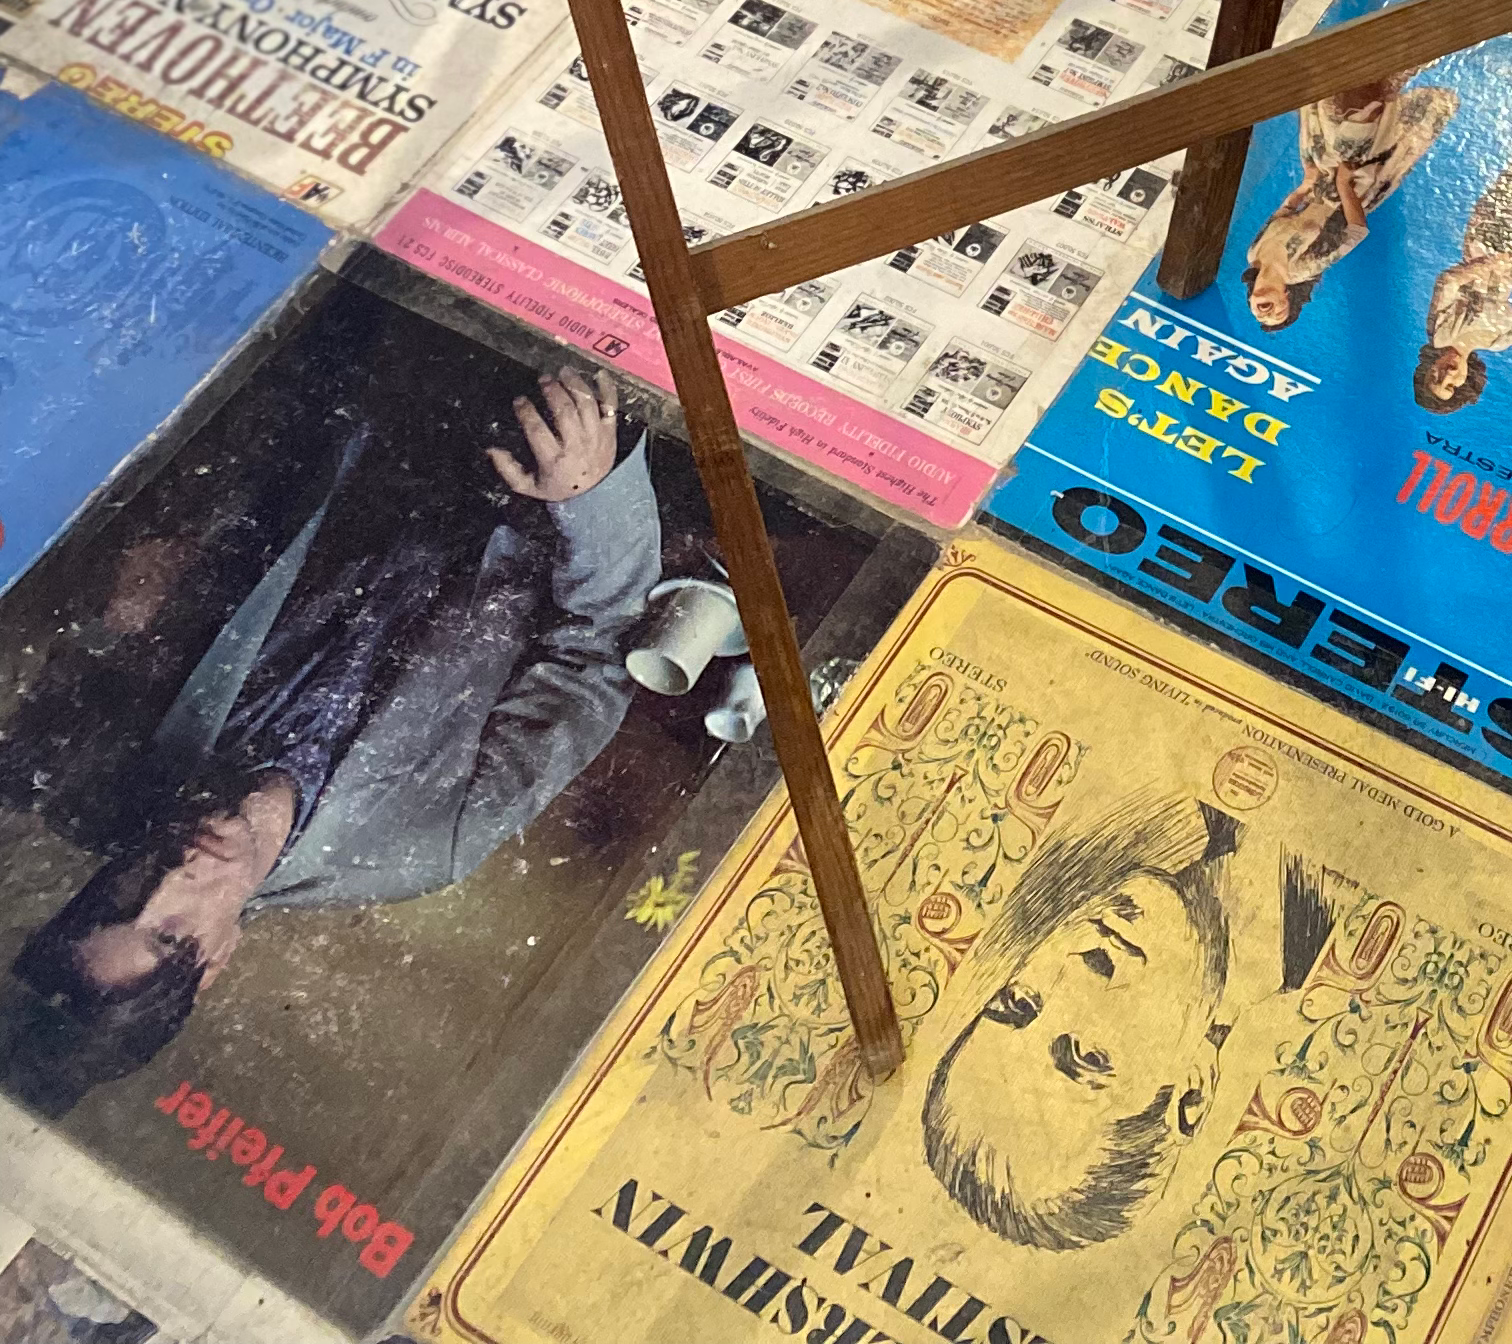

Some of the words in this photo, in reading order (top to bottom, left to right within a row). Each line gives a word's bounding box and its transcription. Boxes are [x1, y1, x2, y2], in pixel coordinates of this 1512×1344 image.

[285, 7, 364, 56] Major
[361, 46, 390, 68] F
[390, 54, 420, 81] in
[56, 59, 232, 164] STEREO
[396, 234, 414, 248] 21
[413, 242, 436, 260] FCS
[438, 255, 504, 293] STEREODISC
[477, 241, 543, 280] CLASSICAL
[505, 290, 555, 319] FIDELITY
[546, 278, 643, 328] STEREOPHONIC
[558, 315, 593, 338] AUDIO
[727, 367, 770, 393] FIRST
[1088, 330, 1286, 443] DANCE
[748, 406, 787, 430] Fidelity
[770, 388, 835, 424] RECORDS
[788, 425, 814, 444] High
[816, 439, 827, 449] in
[841, 421, 905, 460] FIDELITY
[1095, 386, 1261, 481] LET'S
[826, 446, 875, 474] Standard
[907, 455, 952, 484] AUDIO
[875, 469, 915, 494] Highest
[916, 490, 937, 506] The
[928, 645, 1007, 692] STEREO
[1084, 648, 1140, 679] SOUND"
[1139, 673, 1190, 705] "LIVING
[1403, 666, 1479, 712] HI-FI
[1242, 723, 1346, 783] PRESENTATION
[1350, 776, 1401, 809] MEDAL
[1402, 803, 1445, 831] GOLD
[1448, 824, 1460, 837] A
[155, 1081, 315, 1208] Pfeifer
[311, 1183, 413, 1276] Bob
[796, 1203, 1044, 1344] STIVAL
